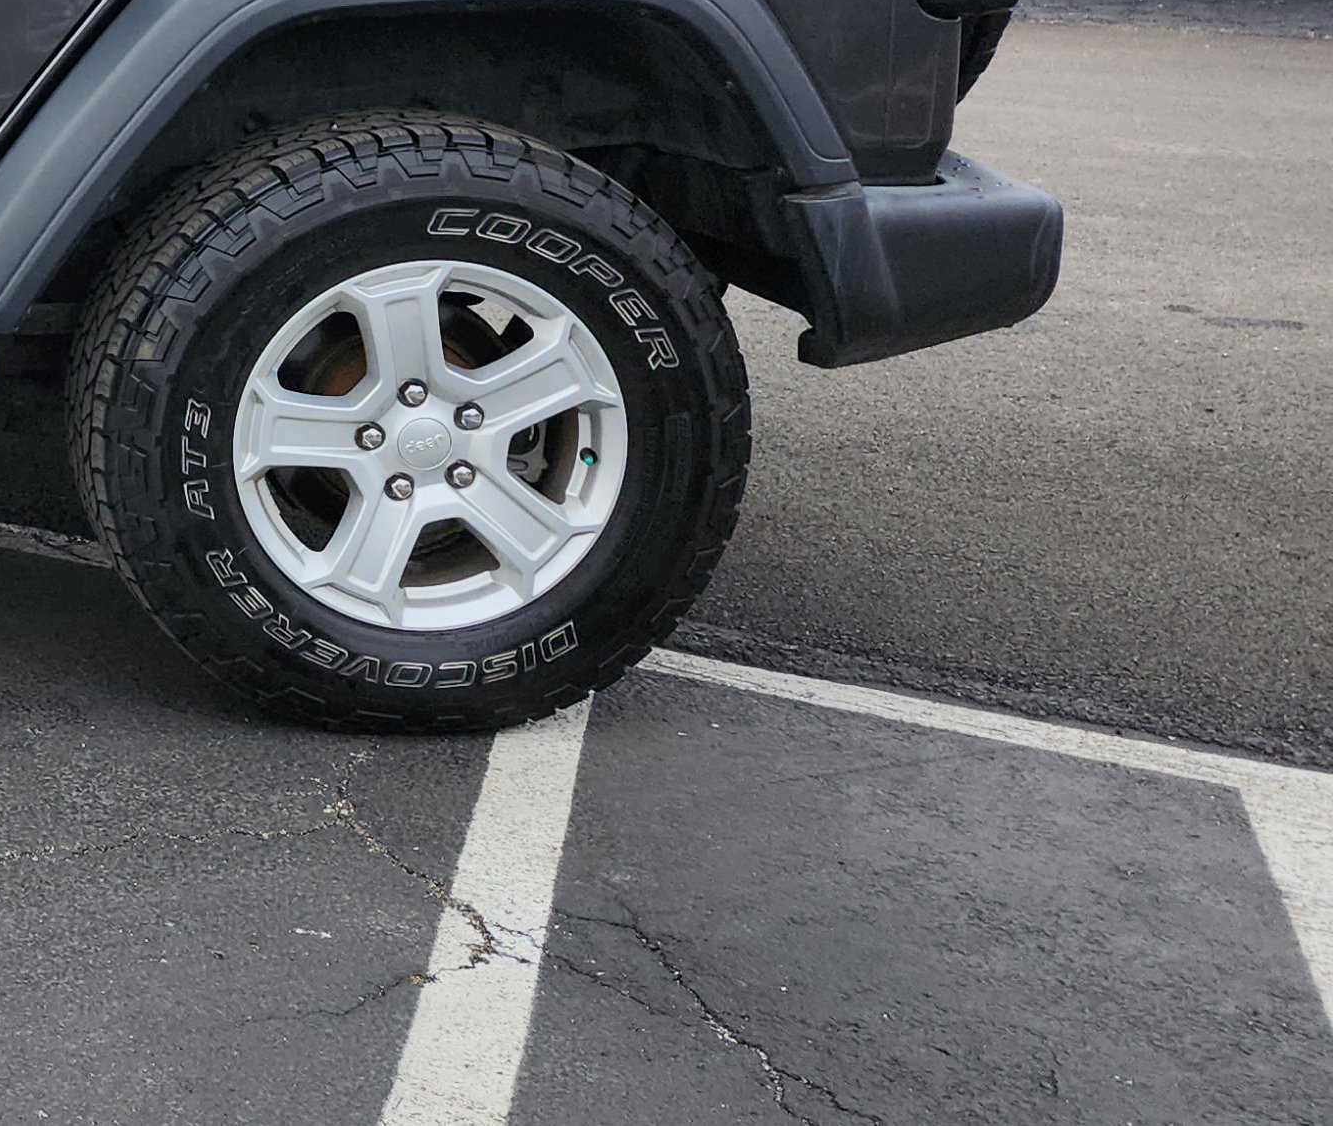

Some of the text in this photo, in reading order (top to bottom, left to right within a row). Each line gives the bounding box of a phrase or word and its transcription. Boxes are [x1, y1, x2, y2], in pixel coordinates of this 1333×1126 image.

[426, 207, 680, 371] COOPER
[181, 396, 580, 690] DISCOVERER AT3
